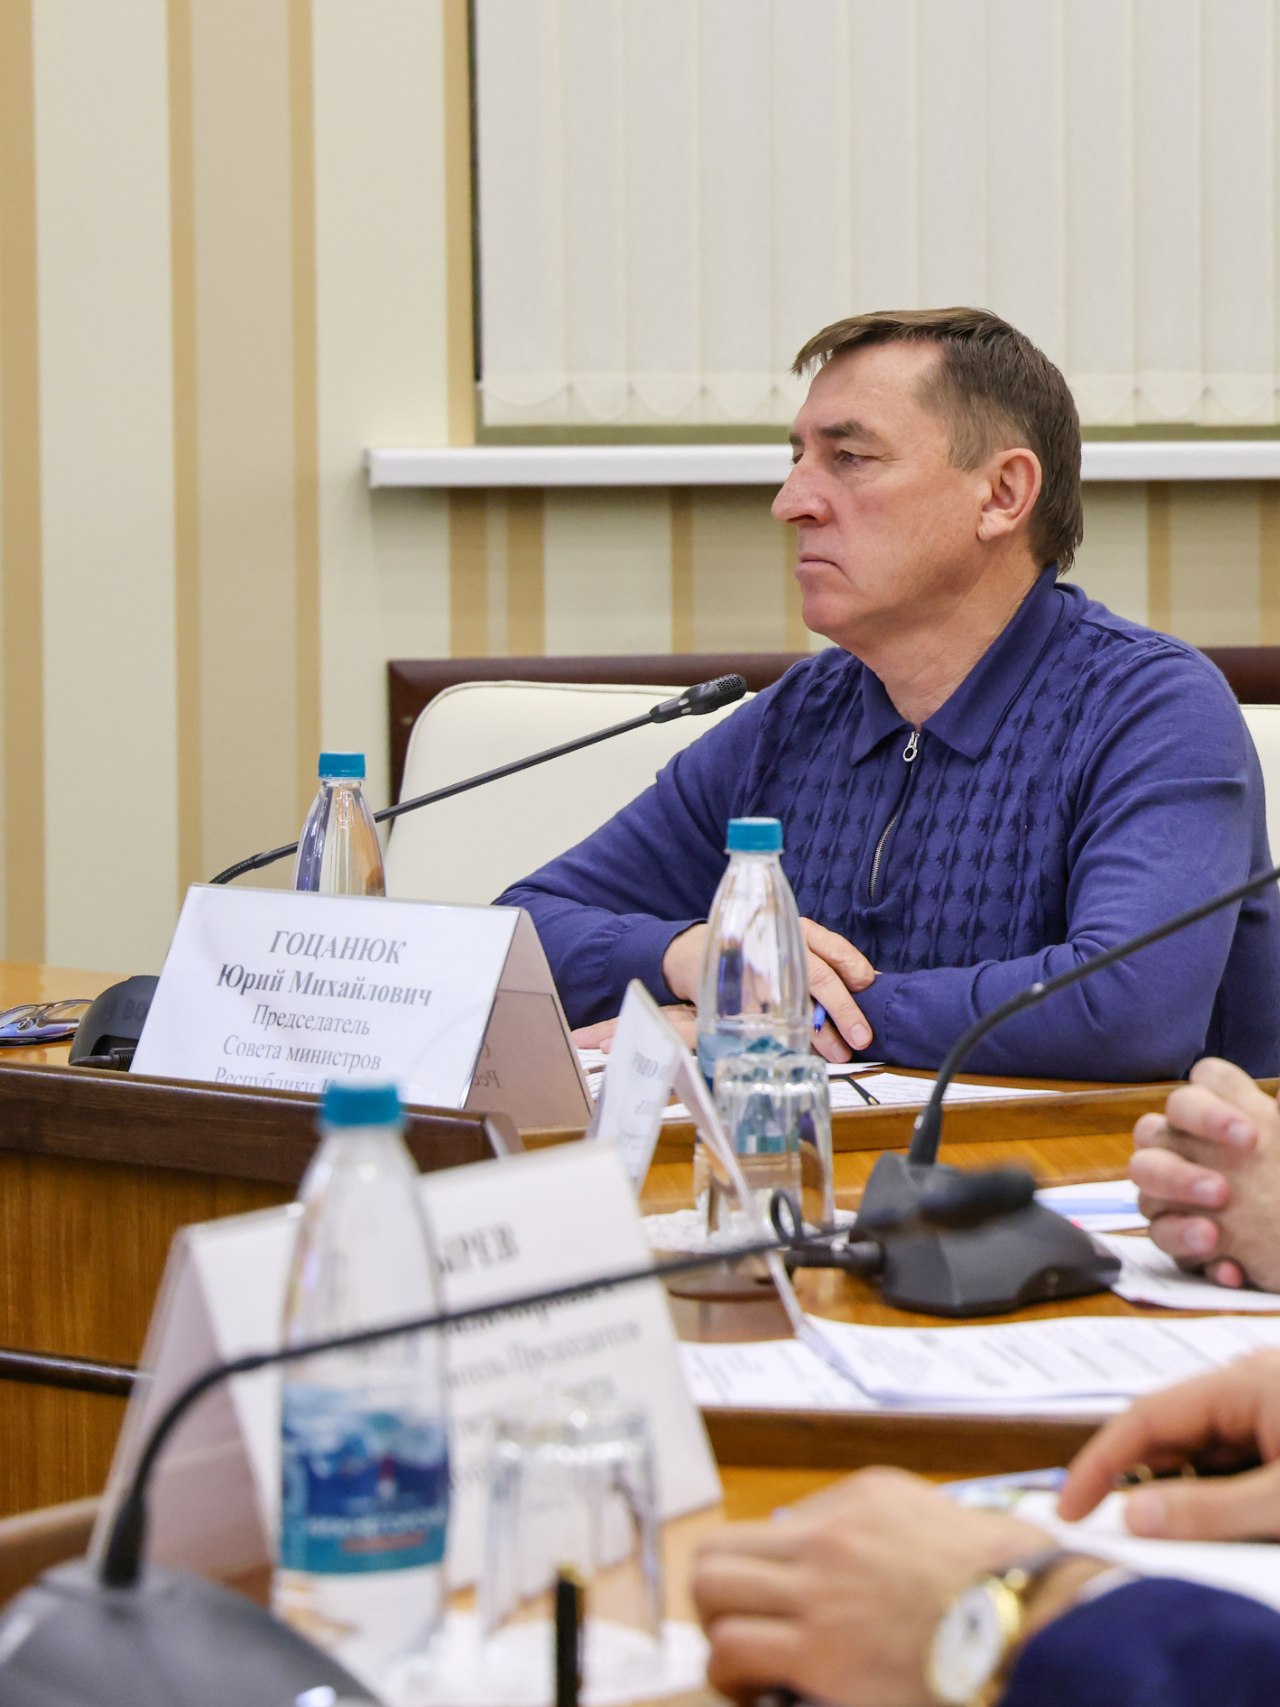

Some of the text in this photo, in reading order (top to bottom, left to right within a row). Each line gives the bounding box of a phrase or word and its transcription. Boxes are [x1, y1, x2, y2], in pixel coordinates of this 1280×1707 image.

[269, 930, 407, 964] ГОЦАНЮК
[216, 963, 432, 1007] Юрий Михайлович
[251, 1003, 371, 1036] Председатель
[223, 1034, 382, 1073] Совета министров
